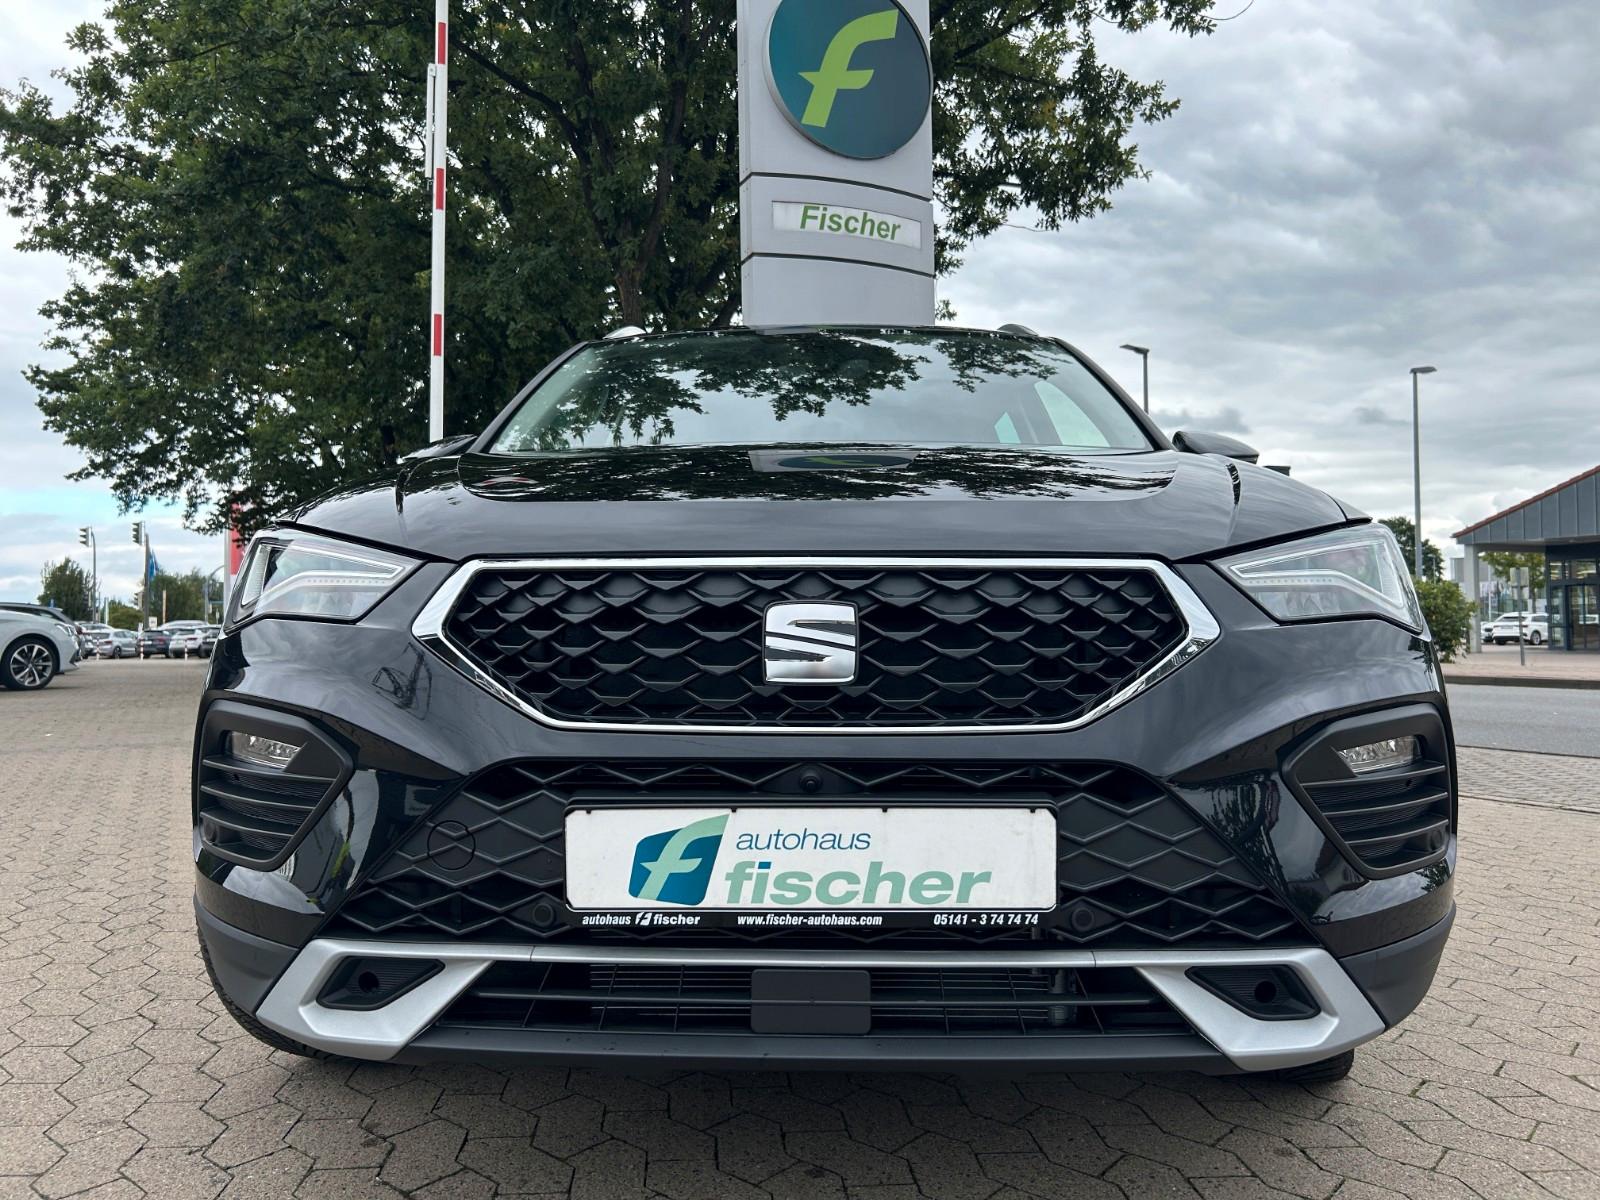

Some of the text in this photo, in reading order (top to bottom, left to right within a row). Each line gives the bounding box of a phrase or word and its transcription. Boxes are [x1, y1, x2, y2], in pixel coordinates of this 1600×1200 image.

[799, 204, 901, 241] Fischer
[736, 828, 871, 851] autohaus
[724, 860, 993, 906] fischer
[582, 913, 632, 925] autohaus
[653, 913, 701, 925] fischer
[737, 913, 883, 926] www.fischer-autohaus.com
[933, 913, 968, 925] 05141
